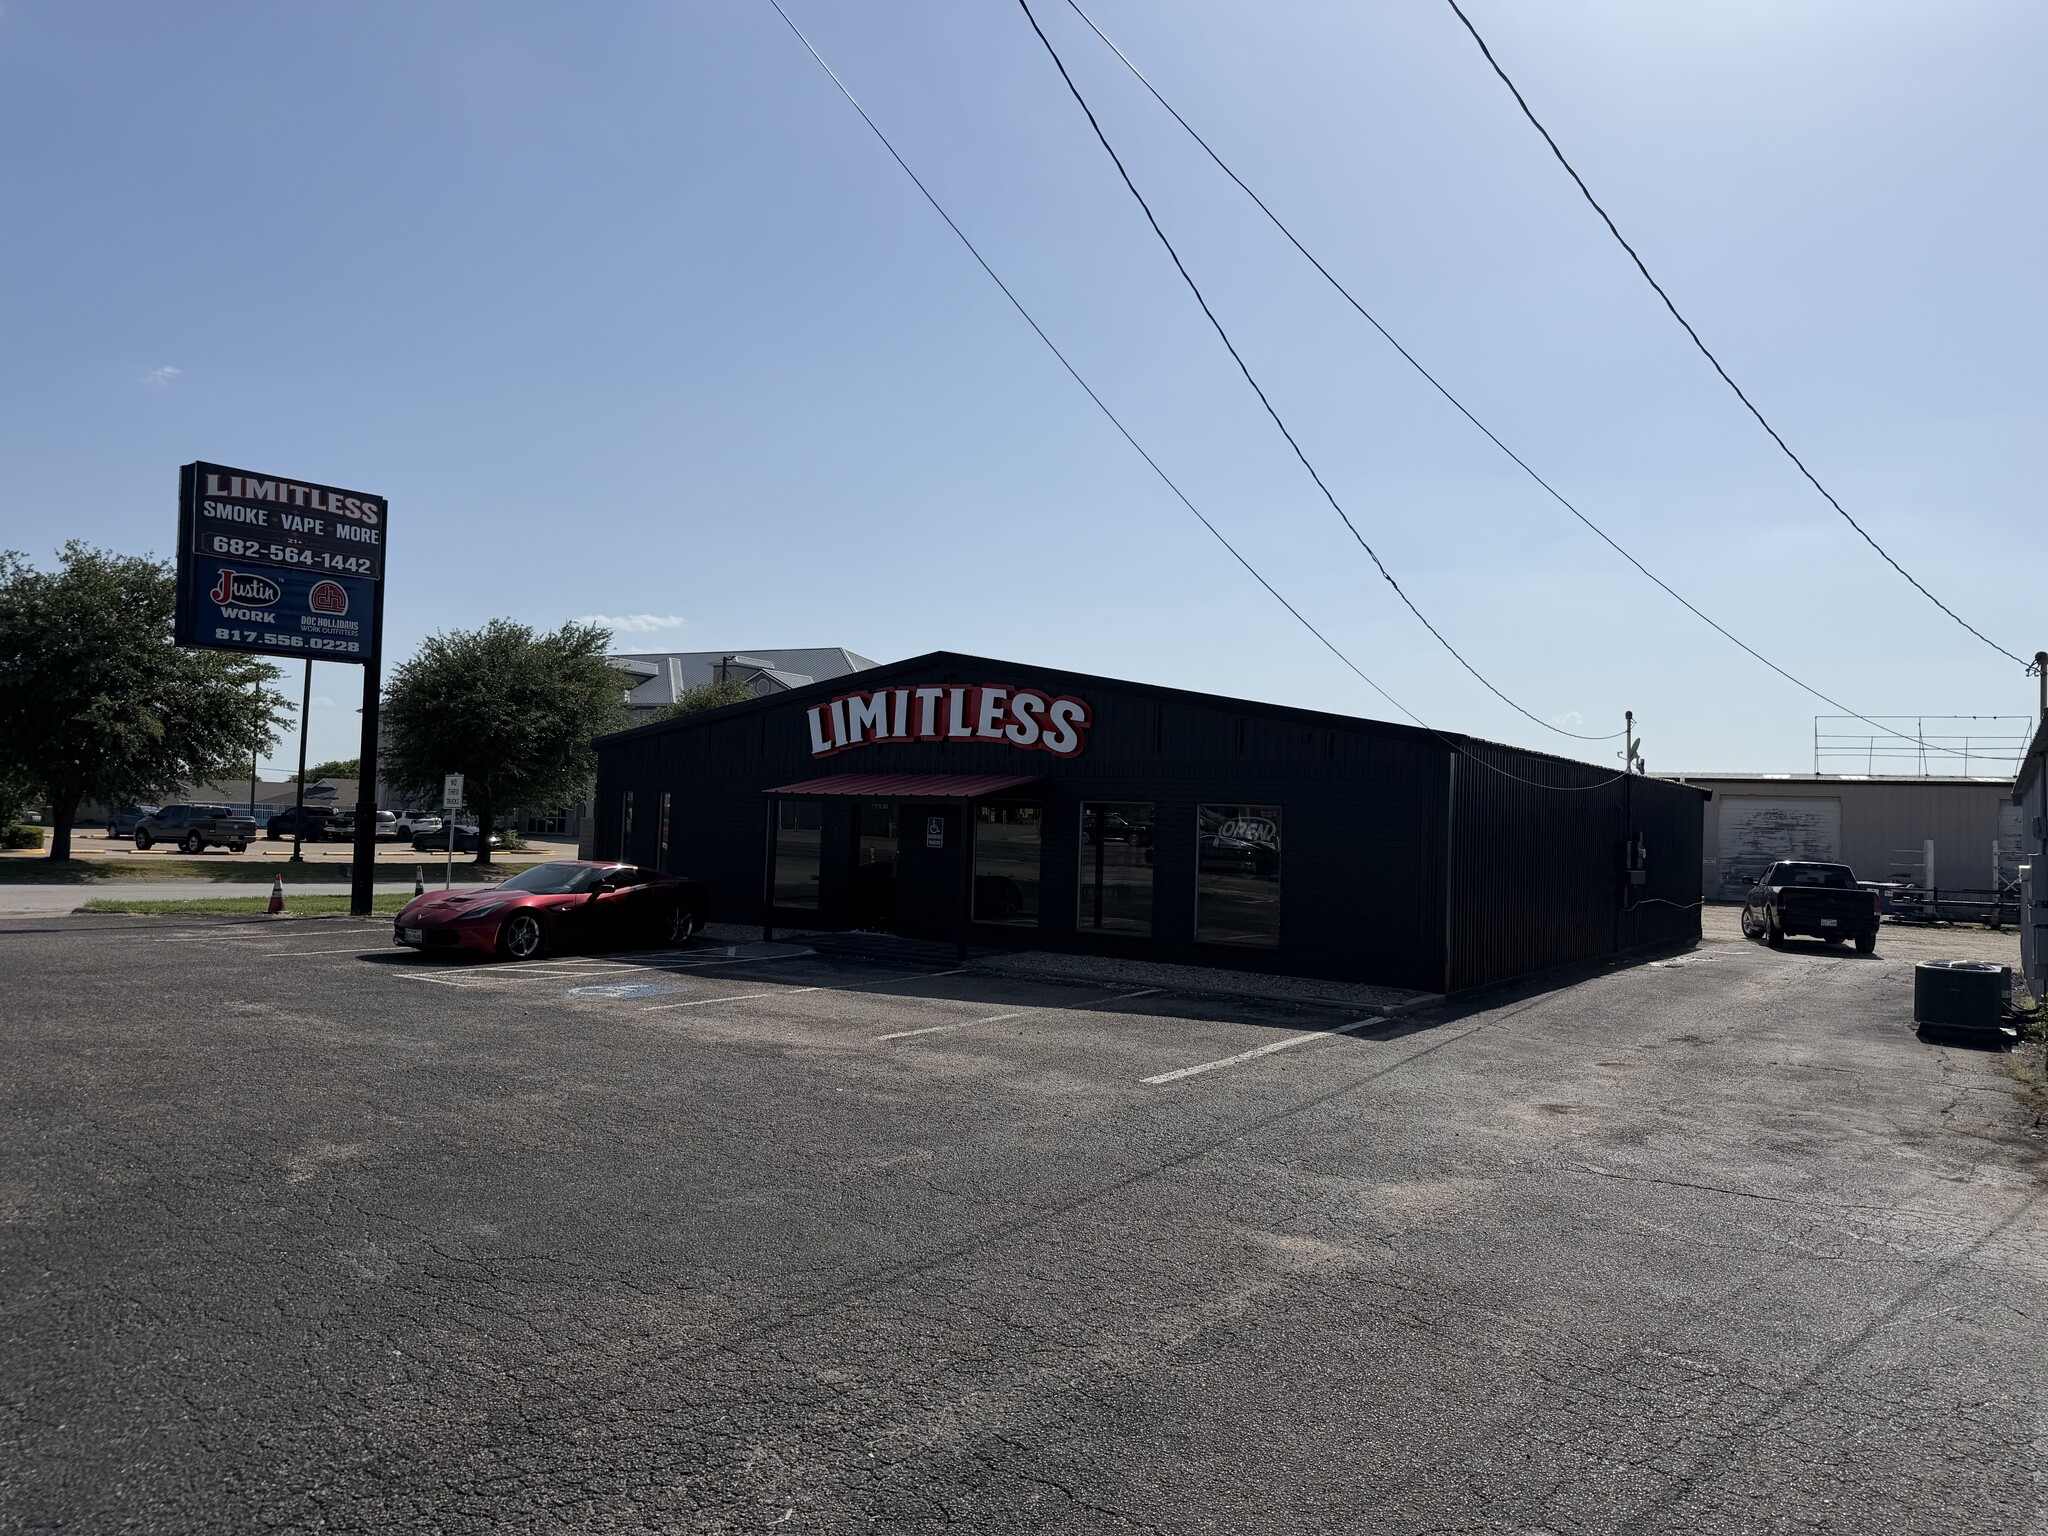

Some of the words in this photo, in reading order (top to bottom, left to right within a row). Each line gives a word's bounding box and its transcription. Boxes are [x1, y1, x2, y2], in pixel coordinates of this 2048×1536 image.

[206, 474, 378, 524] LIMITLESS
[203, 500, 268, 527] SMOKE
[281, 513, 324, 536] VAPE
[336, 523, 379, 545] MORE
[213, 536, 371, 574] 682-564-1442
[210, 569, 275, 604] Justin
[220, 606, 276, 624] WORK
[301, 616, 317, 626] DOC
[317, 617, 359, 631] HOLLIDAYS
[215, 628, 360, 653] 817.556.0228
[301, 624, 321, 634] WORK
[322, 627, 359, 637] OUTFITTERS
[807, 687, 1086, 754] LIMITLESS
[1222, 820, 1271, 841] OPEN
